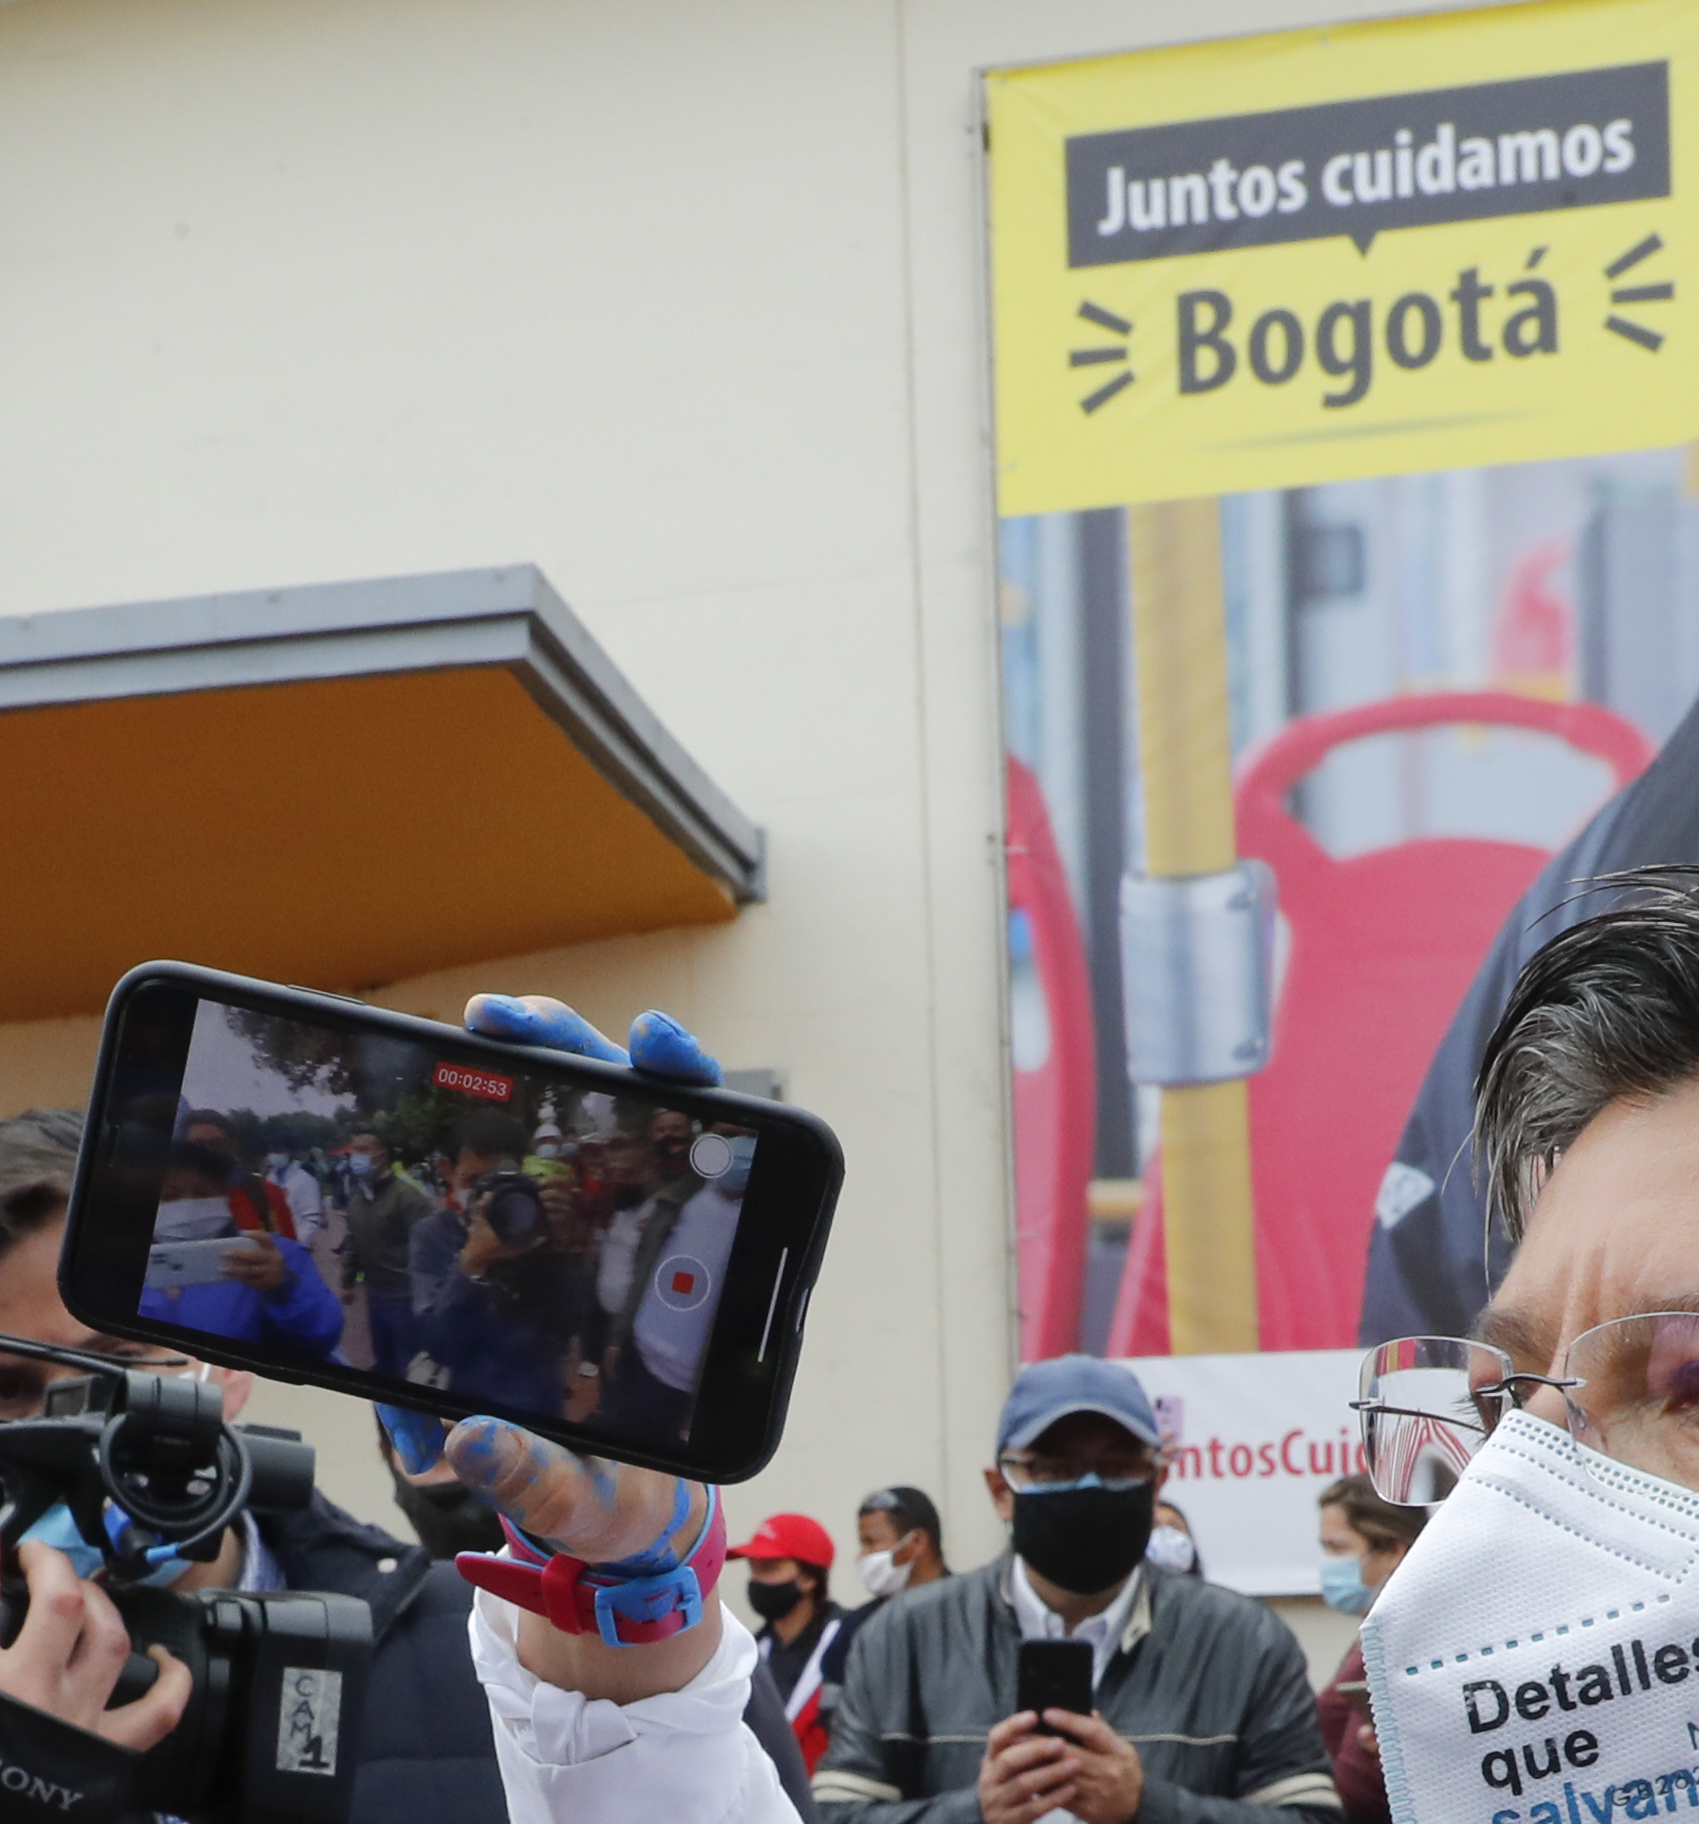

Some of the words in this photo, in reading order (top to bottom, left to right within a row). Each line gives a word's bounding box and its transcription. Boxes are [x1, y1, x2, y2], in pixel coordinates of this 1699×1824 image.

[1096, 164, 1307, 238] Juntos
[1320, 117, 1635, 206] cuidamos
[1176, 245, 1560, 411] Bogotá
[438, 1068, 508, 1097] 00:02:53
[1480, 1728, 1601, 1797] que
